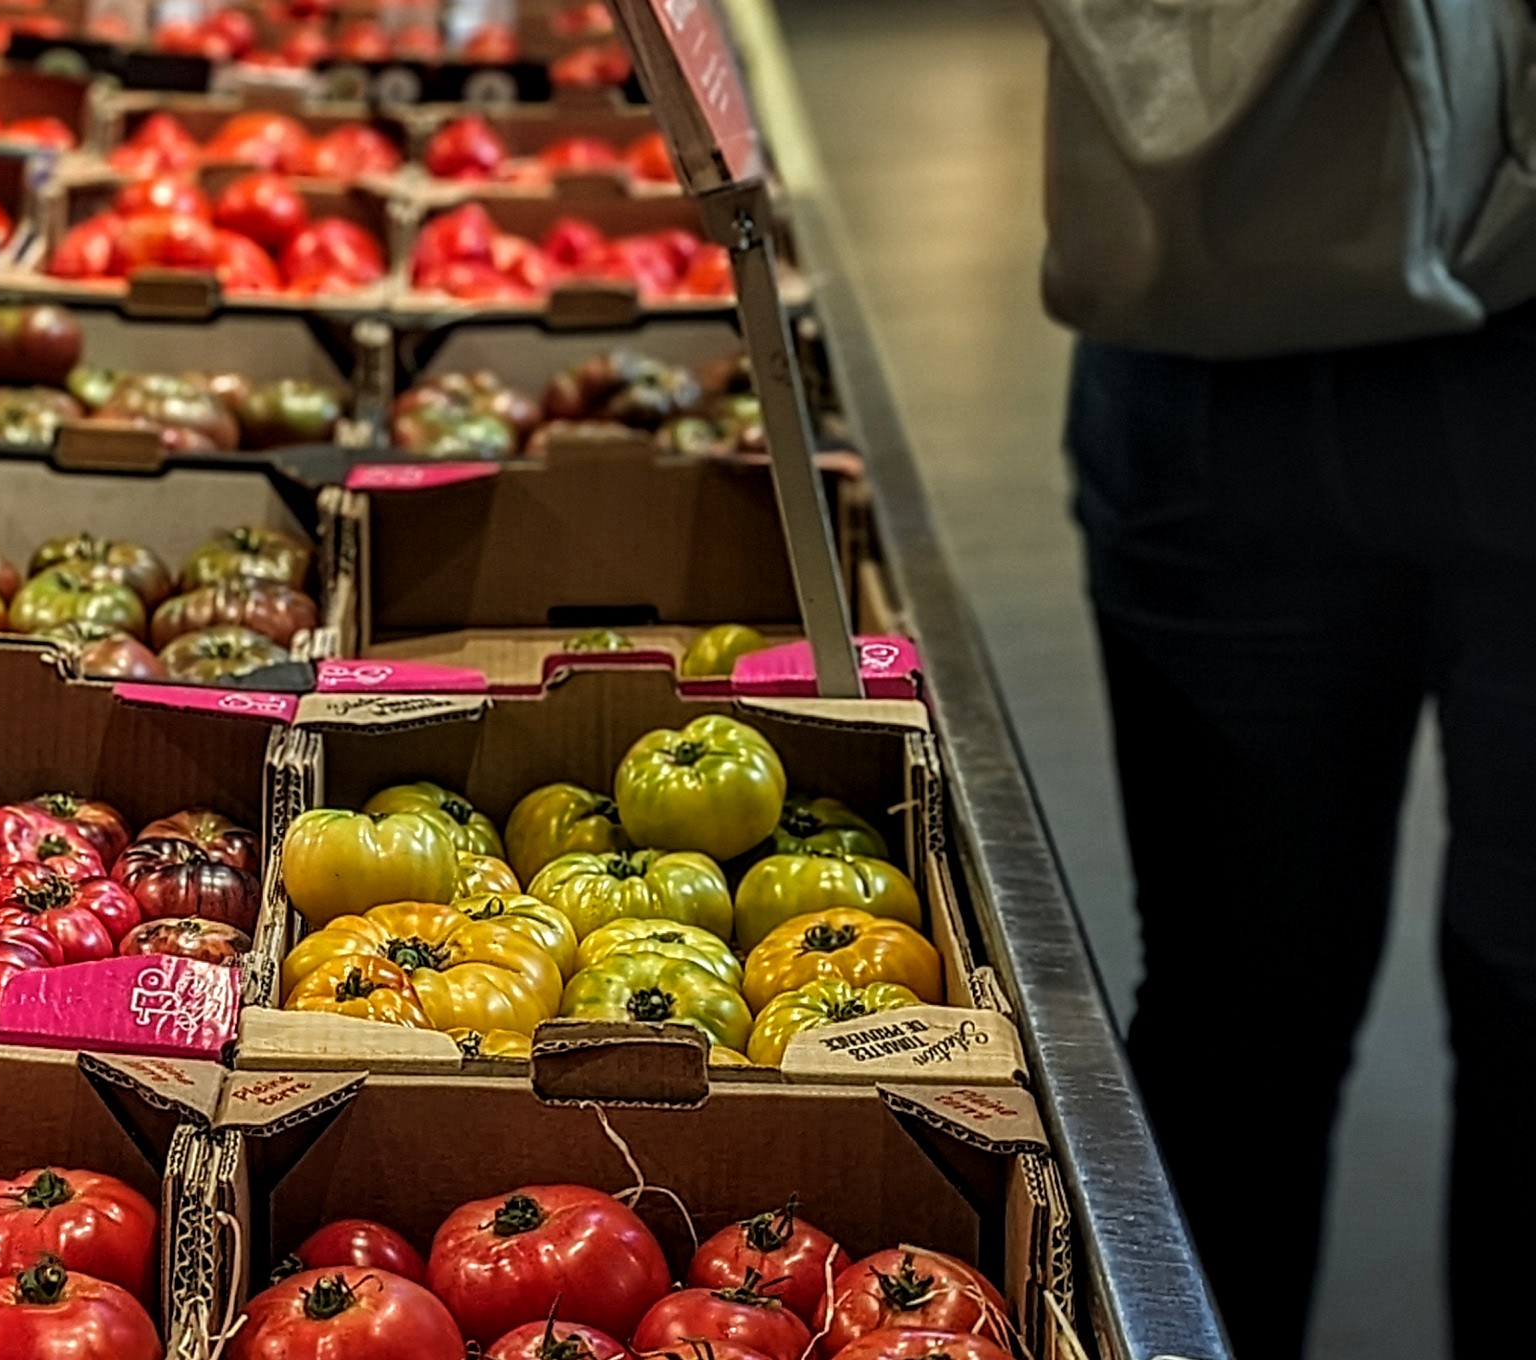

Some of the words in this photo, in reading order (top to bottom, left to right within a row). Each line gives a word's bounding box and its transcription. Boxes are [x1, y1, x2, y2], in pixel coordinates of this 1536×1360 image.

[820, 1024, 904, 1051] PROVENCE
[904, 1020, 928, 1033] DE
[849, 1035, 929, 1061] TOMATES
[232, 1075, 294, 1101] Pleine
[258, 1082, 311, 1105] terre
